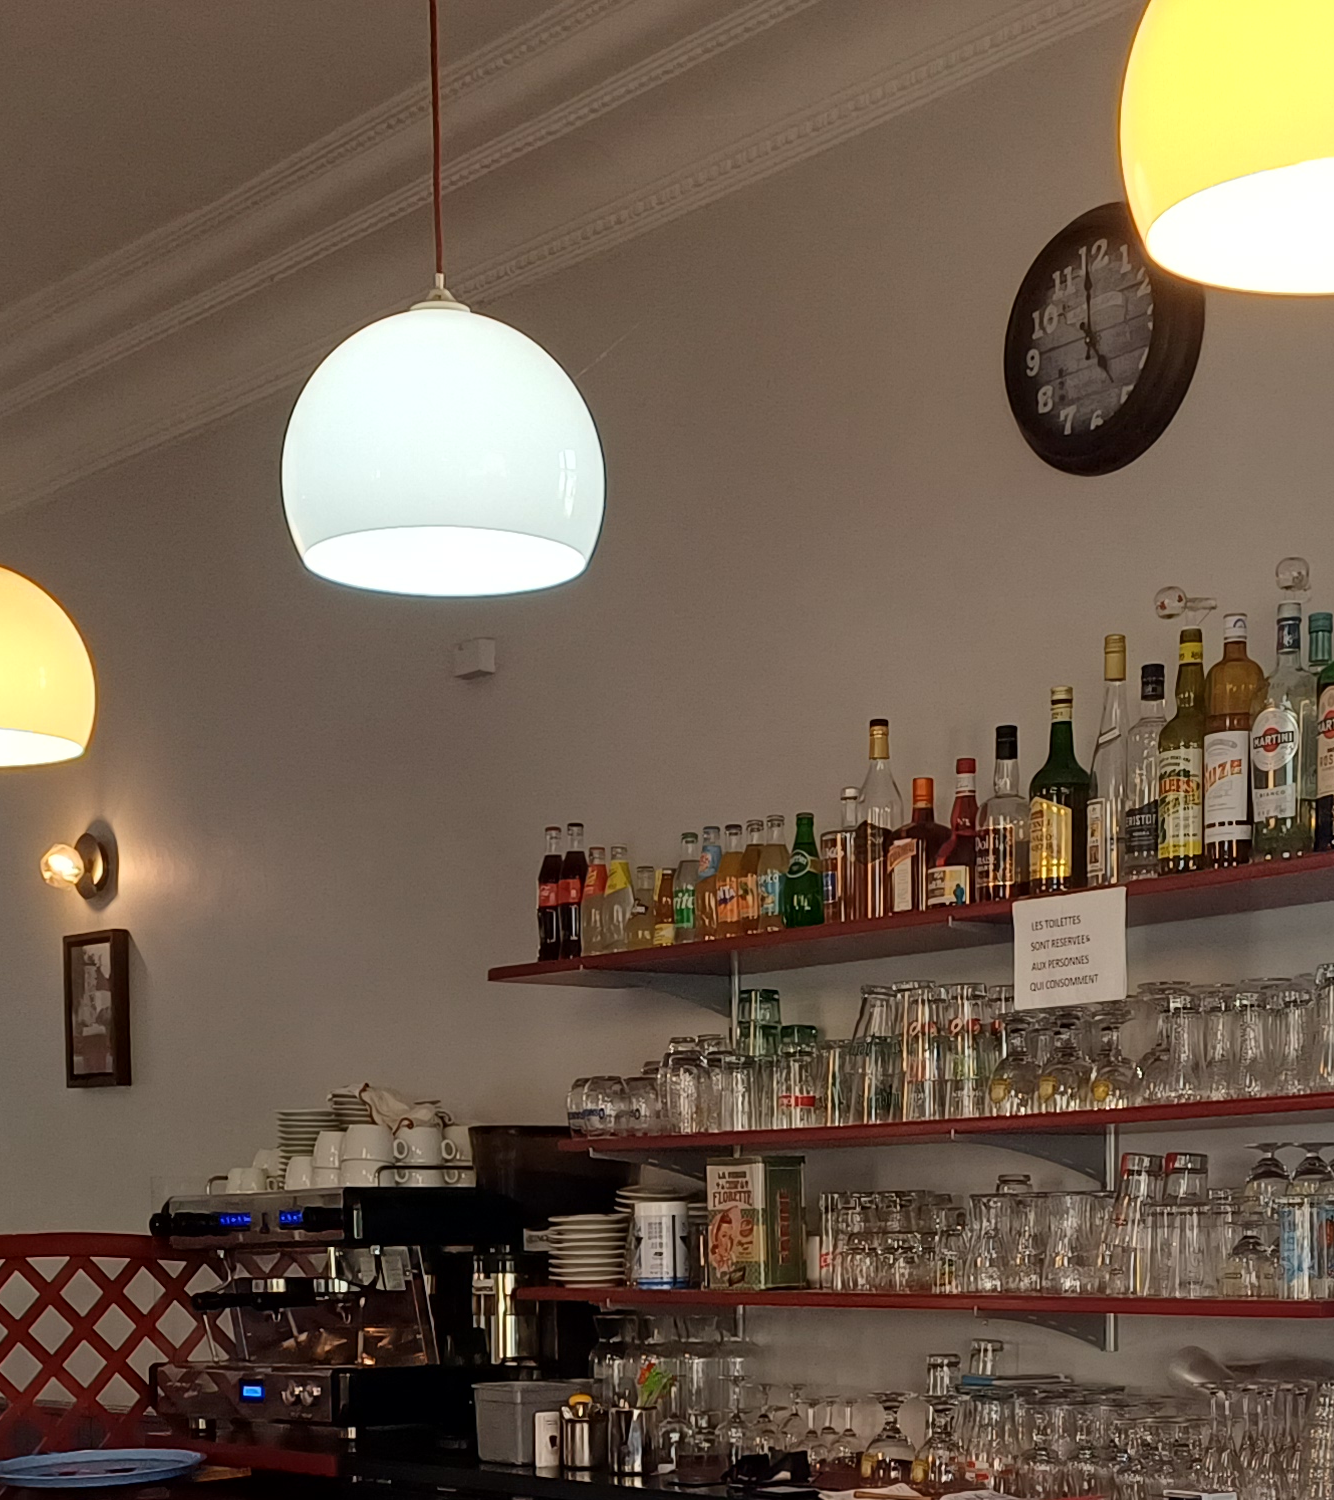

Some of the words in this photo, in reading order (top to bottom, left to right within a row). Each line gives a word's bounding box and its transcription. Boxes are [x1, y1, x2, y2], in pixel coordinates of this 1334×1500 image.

[1078, 238, 1110, 275] 12
[1119, 244, 1132, 274] 1
[1052, 265, 1076, 300] 11
[1031, 303, 1058, 340] 10
[1026, 348, 1041, 377] 9
[1036, 385, 1053, 414] 8
[1059, 404, 1078, 435] 7
[1254, 731, 1294, 749] MARTINI
[1031, 920, 1043, 932] LES
[1045, 915, 1082, 929] TOILETTES
[1030, 939, 1049, 952] SONT
[1031, 961, 1047, 972] AUX
[1048, 954, 1090, 969] PERSONNES
[1029, 981, 1045, 992] QUI
[1045, 973, 1099, 990] CONSOMMENT
[712, 1190, 753, 1208] FLORETTE
